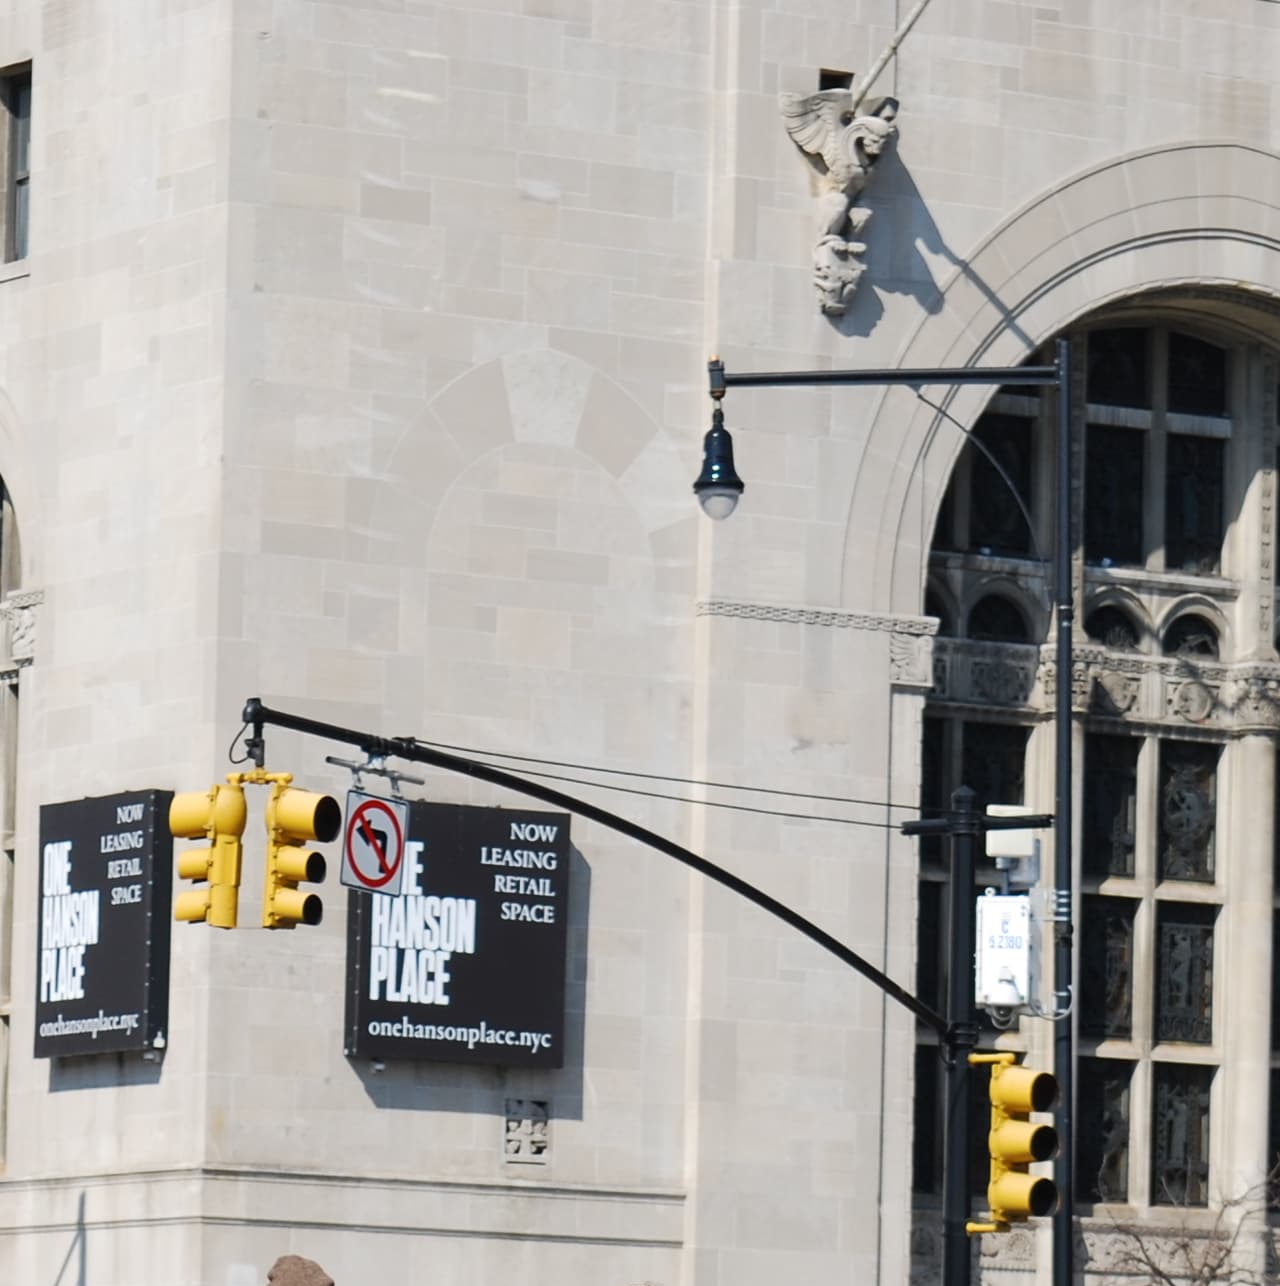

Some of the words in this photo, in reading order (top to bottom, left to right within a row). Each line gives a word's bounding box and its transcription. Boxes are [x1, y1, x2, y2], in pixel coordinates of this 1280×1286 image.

[116, 804, 144, 824] NOW
[100, 831, 144, 853] LEASING
[510, 823, 558, 843] NOW
[43, 841, 72, 896] ONE
[107, 858, 143, 879] RETAIL
[480, 847, 558, 870] LEASING
[111, 885, 142, 905] SPACE
[494, 875, 556, 897] RETAIL
[42, 890, 99, 949] HANSON
[371, 893, 477, 954] HANSON
[500, 903, 555, 924] SPACE
[41, 945, 86, 1003] PLACE
[369, 946, 451, 1006] PLACE
[39, 1009, 140, 1039] onehansonplace.nyc
[368, 1016, 553, 1054] onehansonplace.nyc
